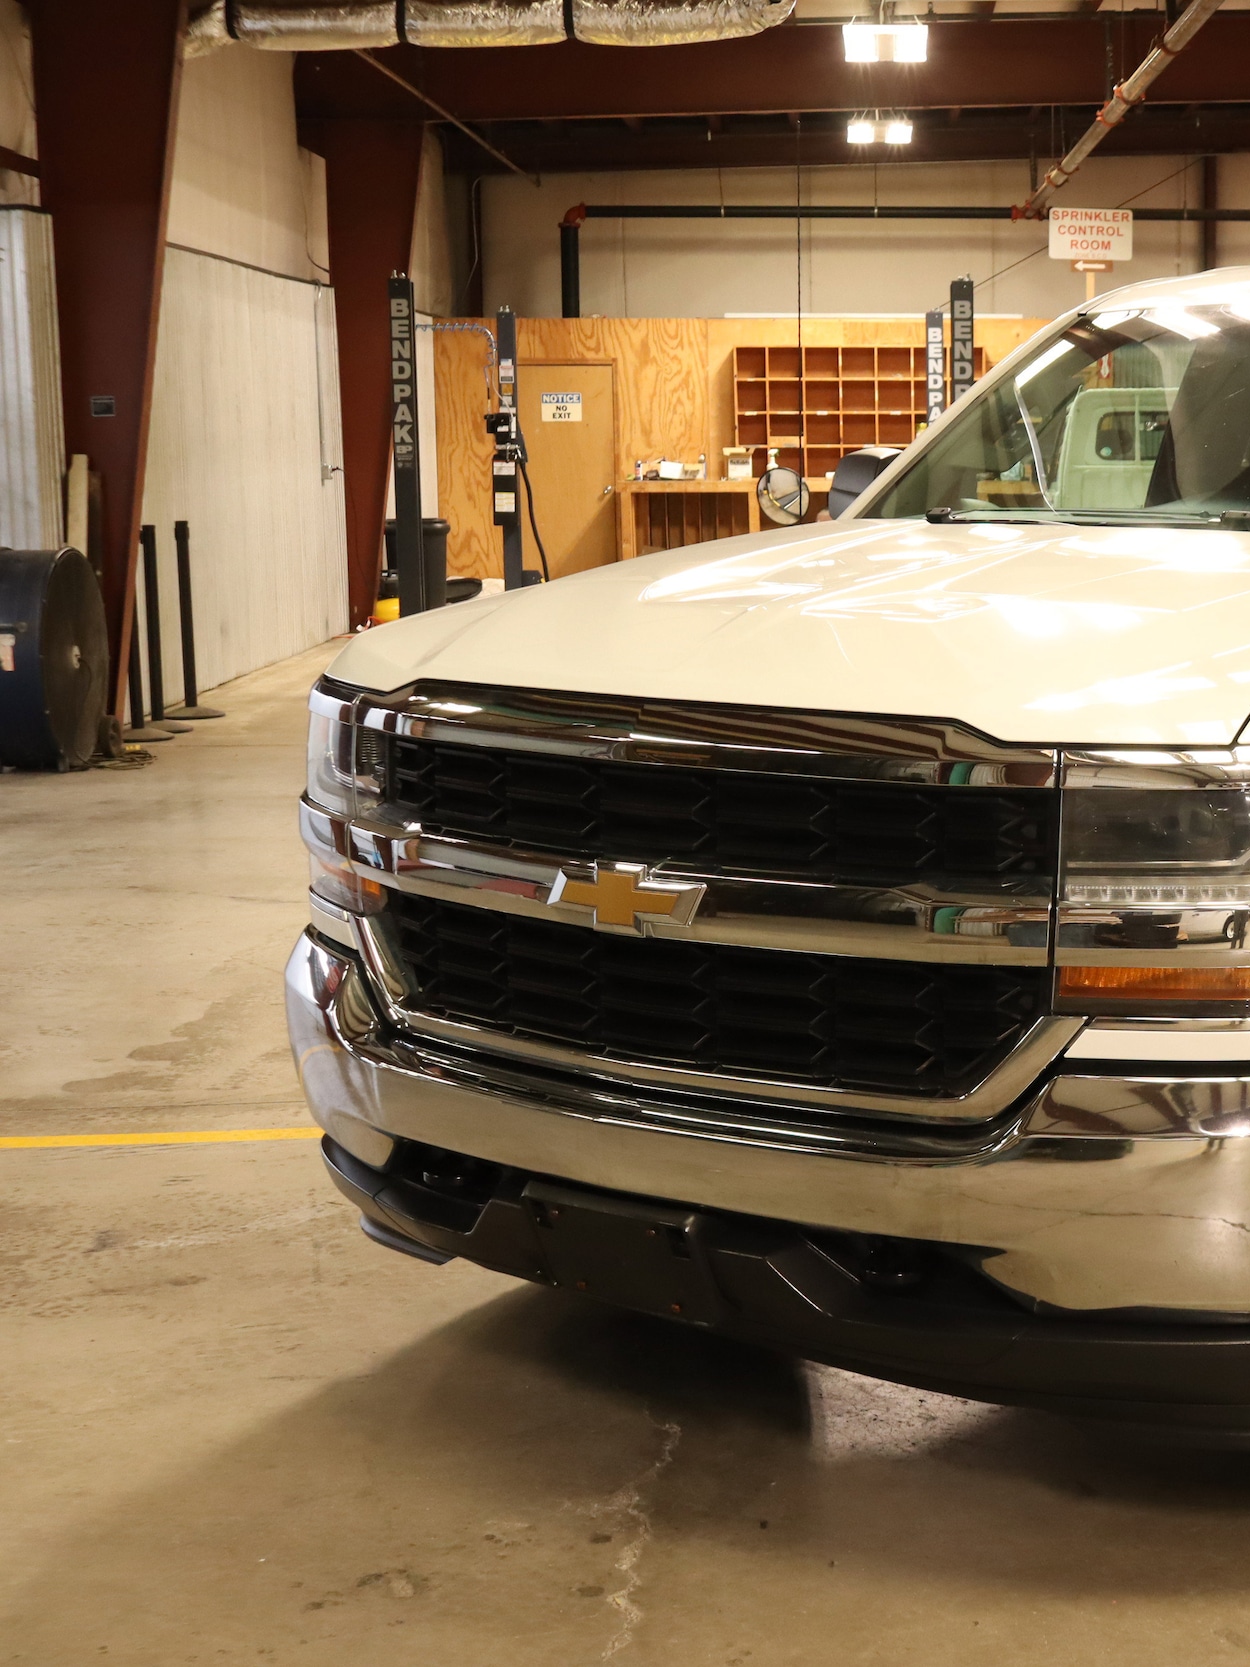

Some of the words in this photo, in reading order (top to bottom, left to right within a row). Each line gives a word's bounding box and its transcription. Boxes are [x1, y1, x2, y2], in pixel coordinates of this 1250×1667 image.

[1052, 210, 1130, 222] SPRINKLER
[1057, 225, 1124, 237] CONTROL
[1070, 239, 1112, 250] ROOM
[390, 298, 413, 443] BENDPAK
[928, 327, 943, 427] BENDPA
[542, 394, 580, 403] NOTICE
